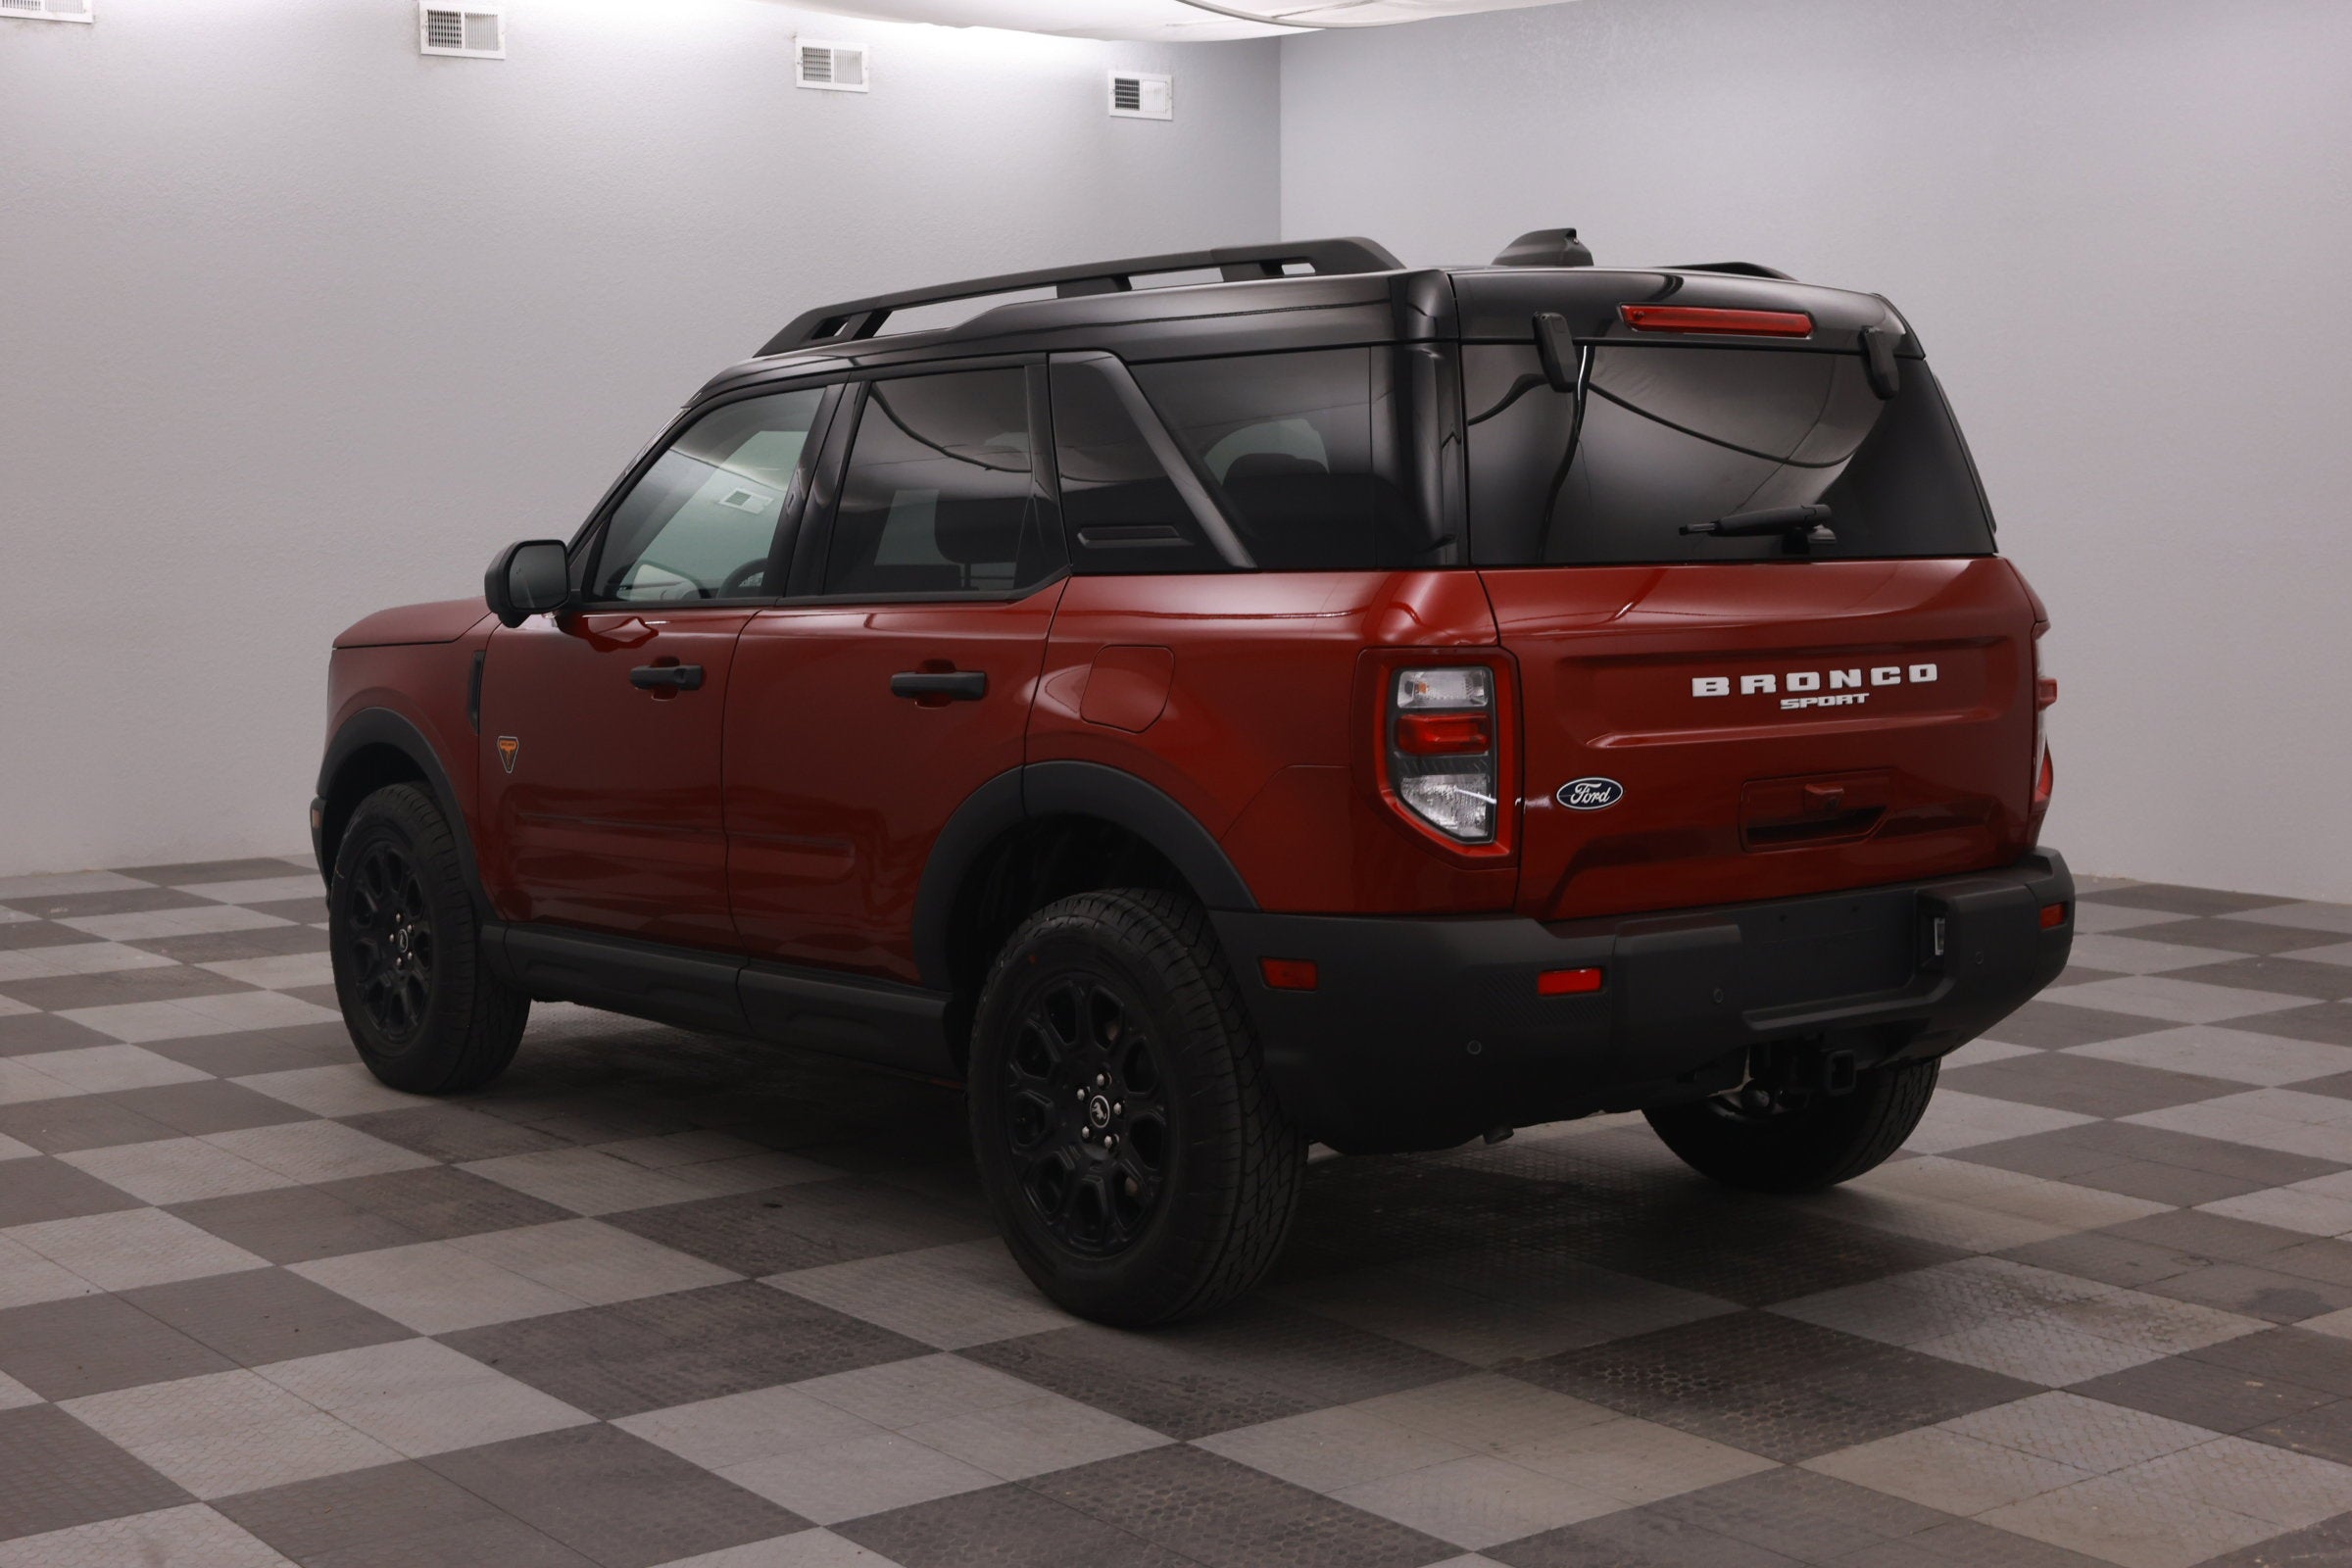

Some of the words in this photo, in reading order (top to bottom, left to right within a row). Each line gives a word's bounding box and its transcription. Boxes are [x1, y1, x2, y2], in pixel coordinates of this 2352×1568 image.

[1691, 663, 1937, 697] BRONCO
[1780, 693, 1869, 710] SPORT
[1570, 782, 1612, 804] Ford
